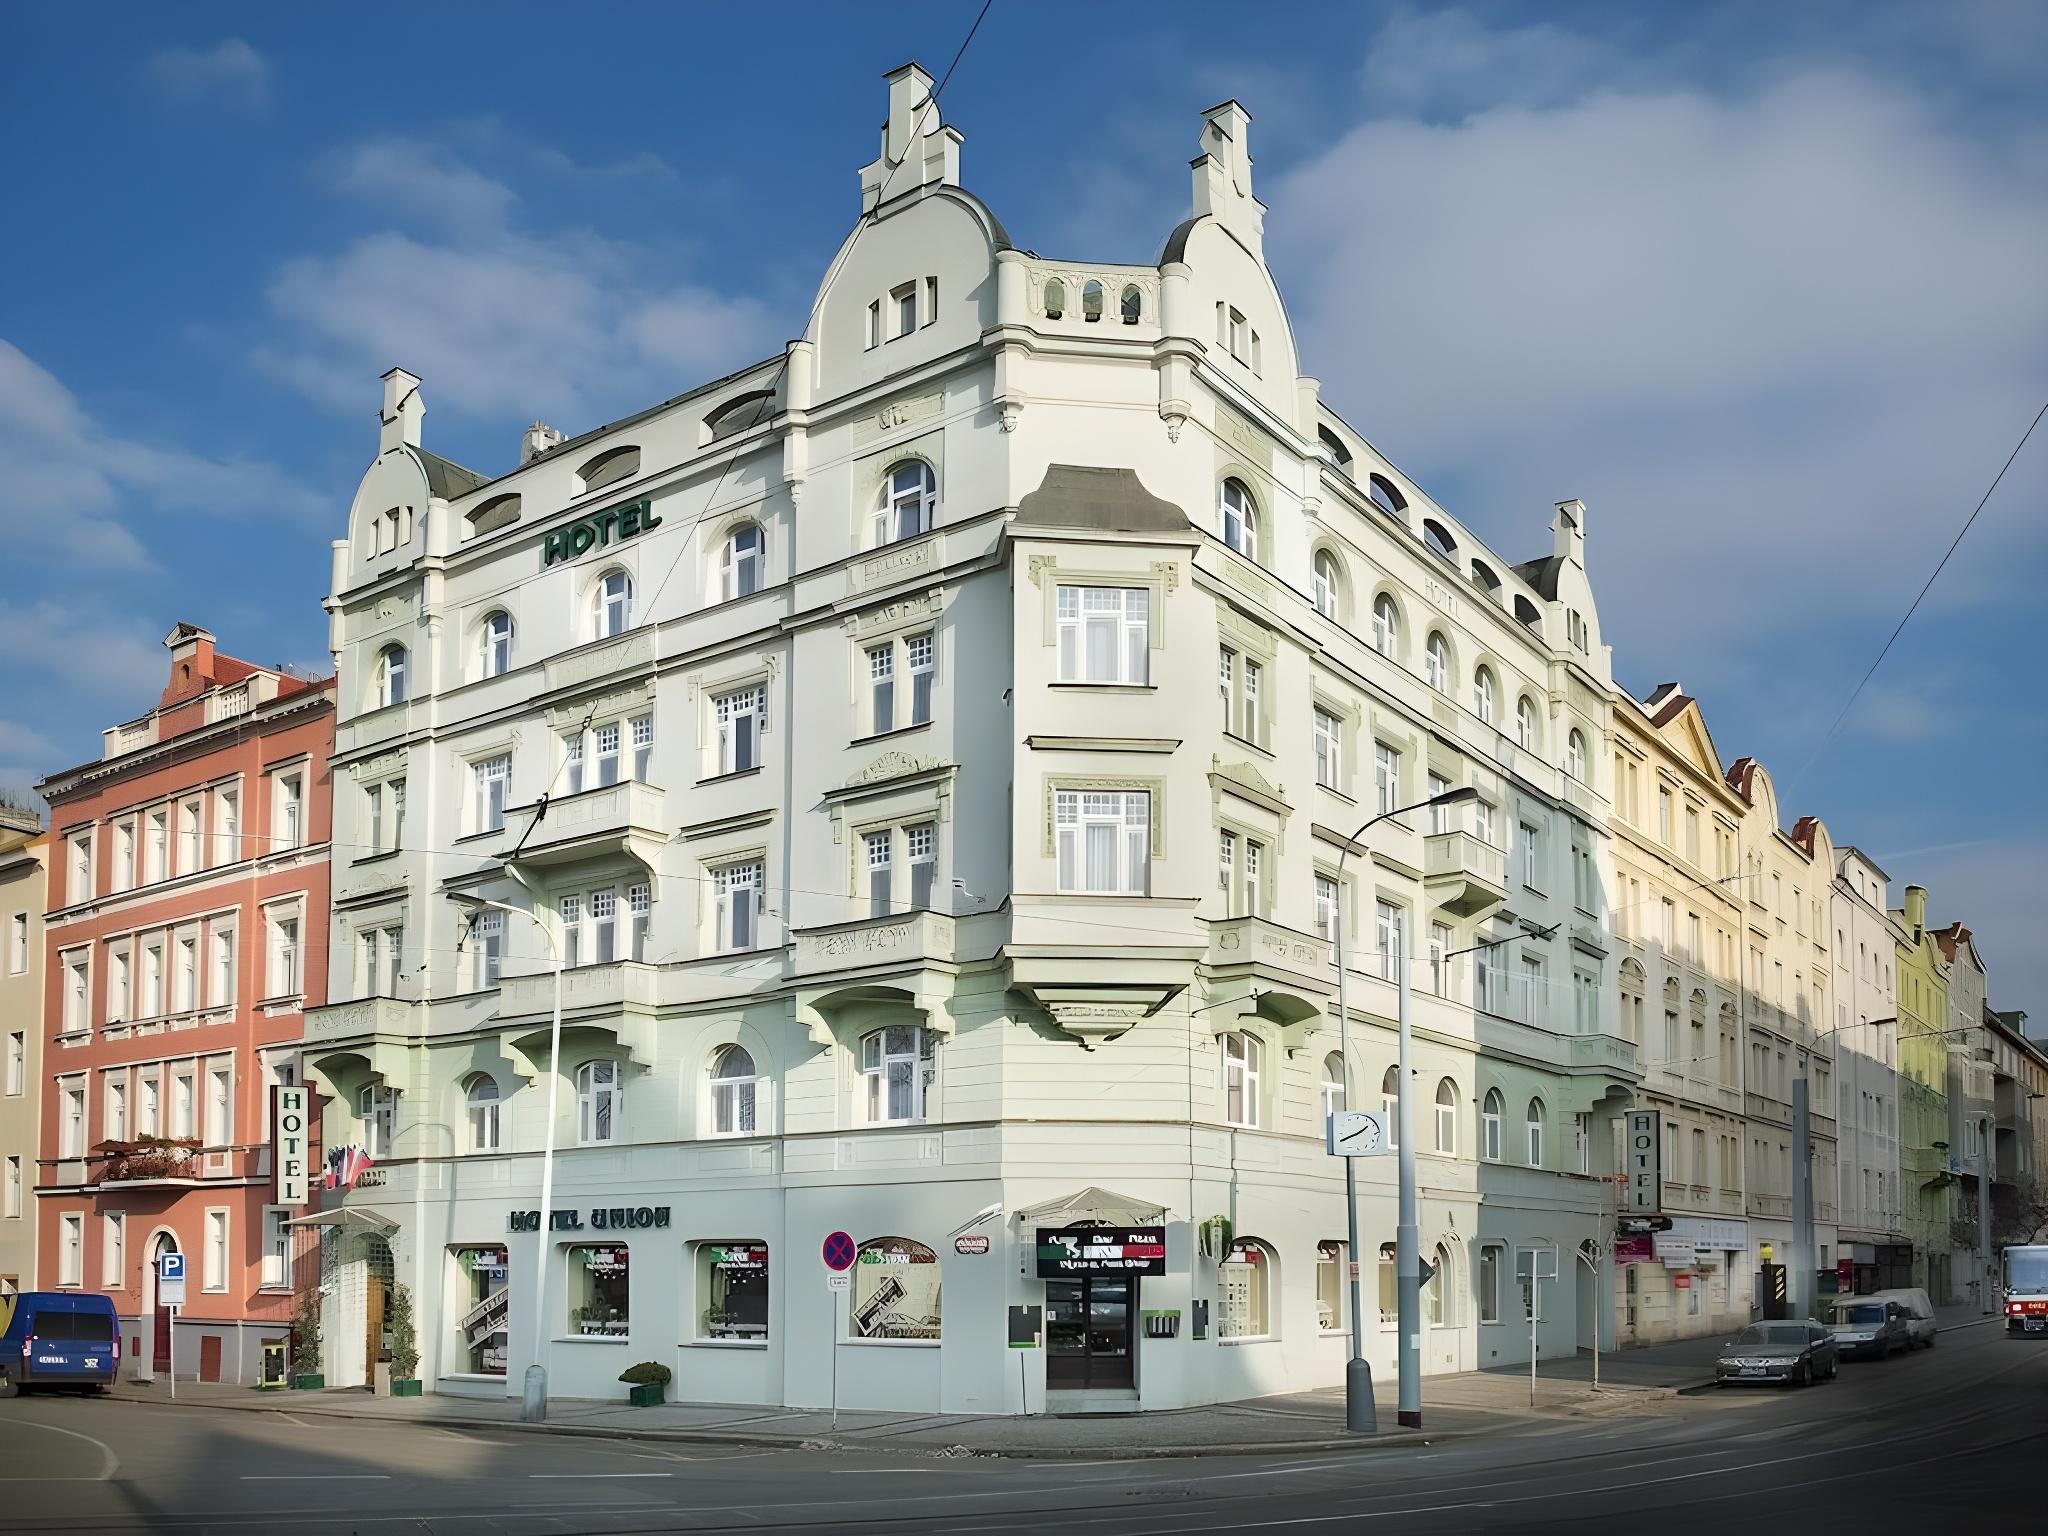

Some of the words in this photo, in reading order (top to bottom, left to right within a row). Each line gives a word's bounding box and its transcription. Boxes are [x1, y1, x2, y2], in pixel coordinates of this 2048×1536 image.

[543, 499, 663, 567] HOTEL
[282, 1092, 301, 1199] HOTEL
[1634, 1116, 1651, 1206] HOTEL
[165, 1257, 180, 1276] P
